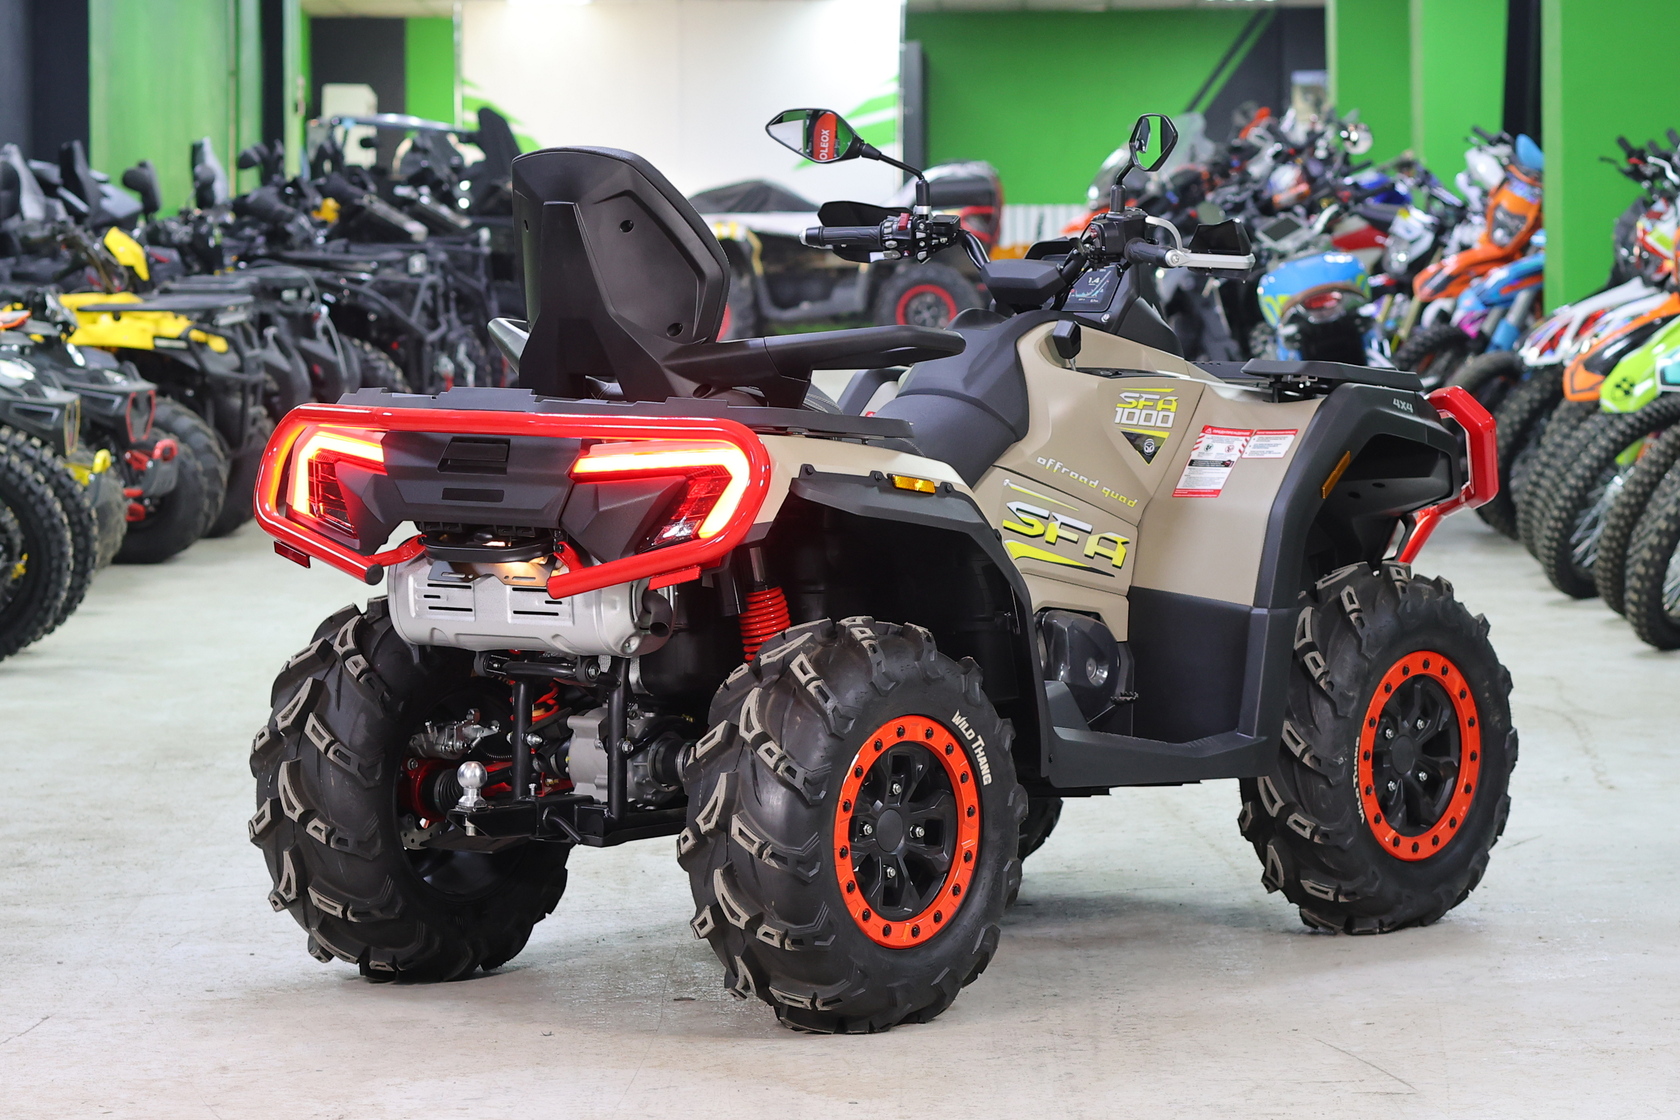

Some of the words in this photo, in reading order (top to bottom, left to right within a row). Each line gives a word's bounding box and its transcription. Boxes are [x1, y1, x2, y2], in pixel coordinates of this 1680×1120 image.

[1114, 407, 1175, 428] 1000
[1116, 392, 1179, 412] SFA
[1037, 456, 1099, 489] offroad
[1101, 486, 1138, 508] quad
[1002, 501, 1130, 569] SFA
